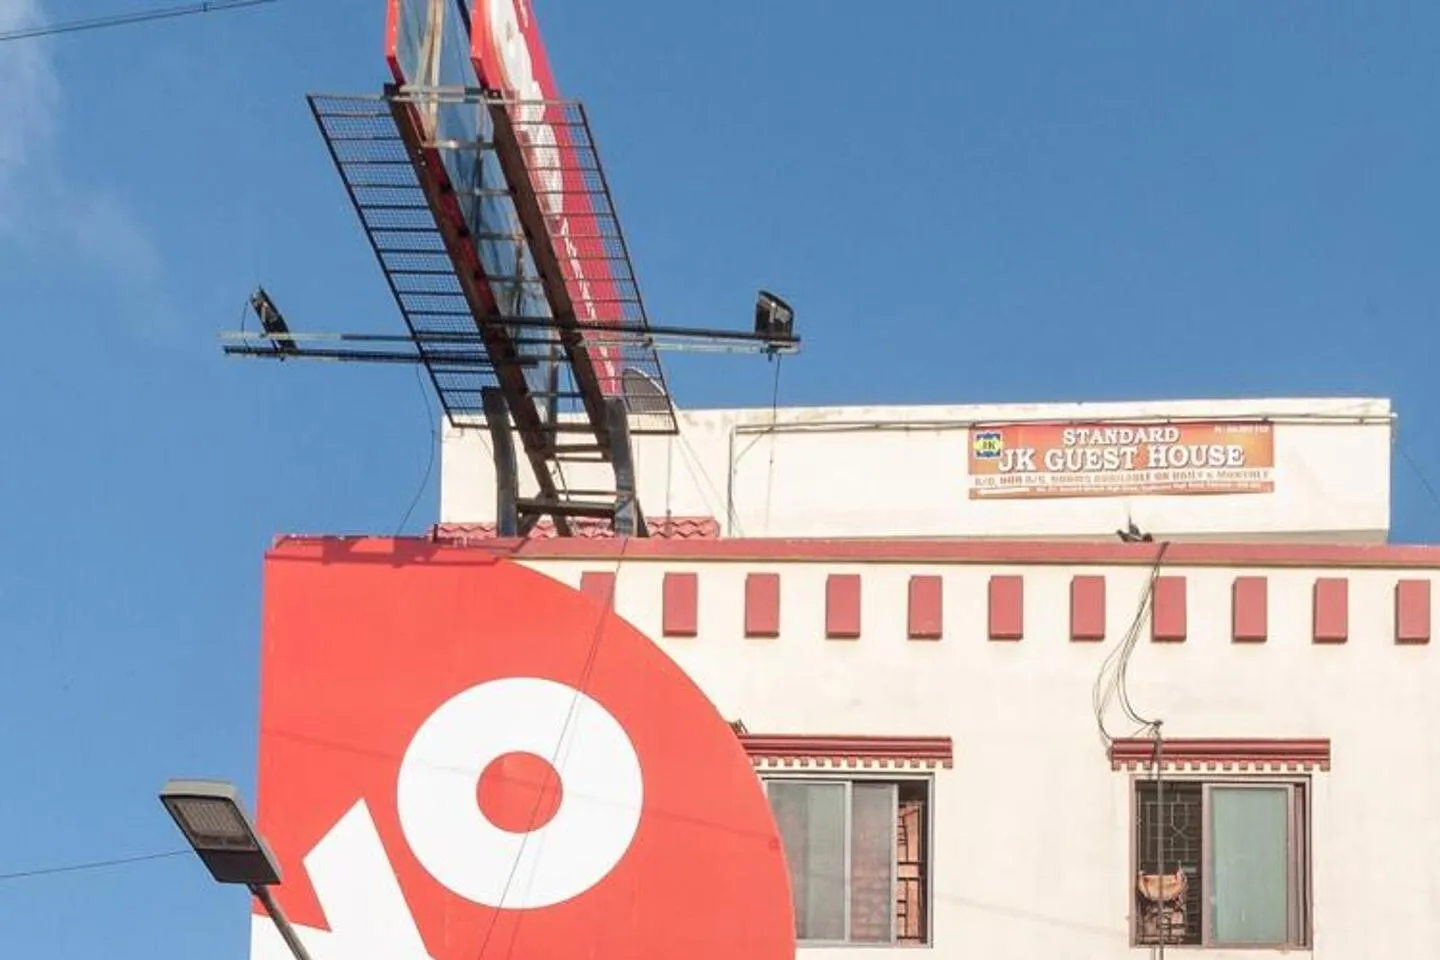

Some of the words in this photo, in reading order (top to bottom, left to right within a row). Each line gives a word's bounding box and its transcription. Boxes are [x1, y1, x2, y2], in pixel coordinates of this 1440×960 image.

[1063, 427, 1181, 445] STANDARD
[998, 448, 1037, 473] JK
[1044, 447, 1138, 472] GUEST
[1148, 444, 1246, 469] HOUSE
